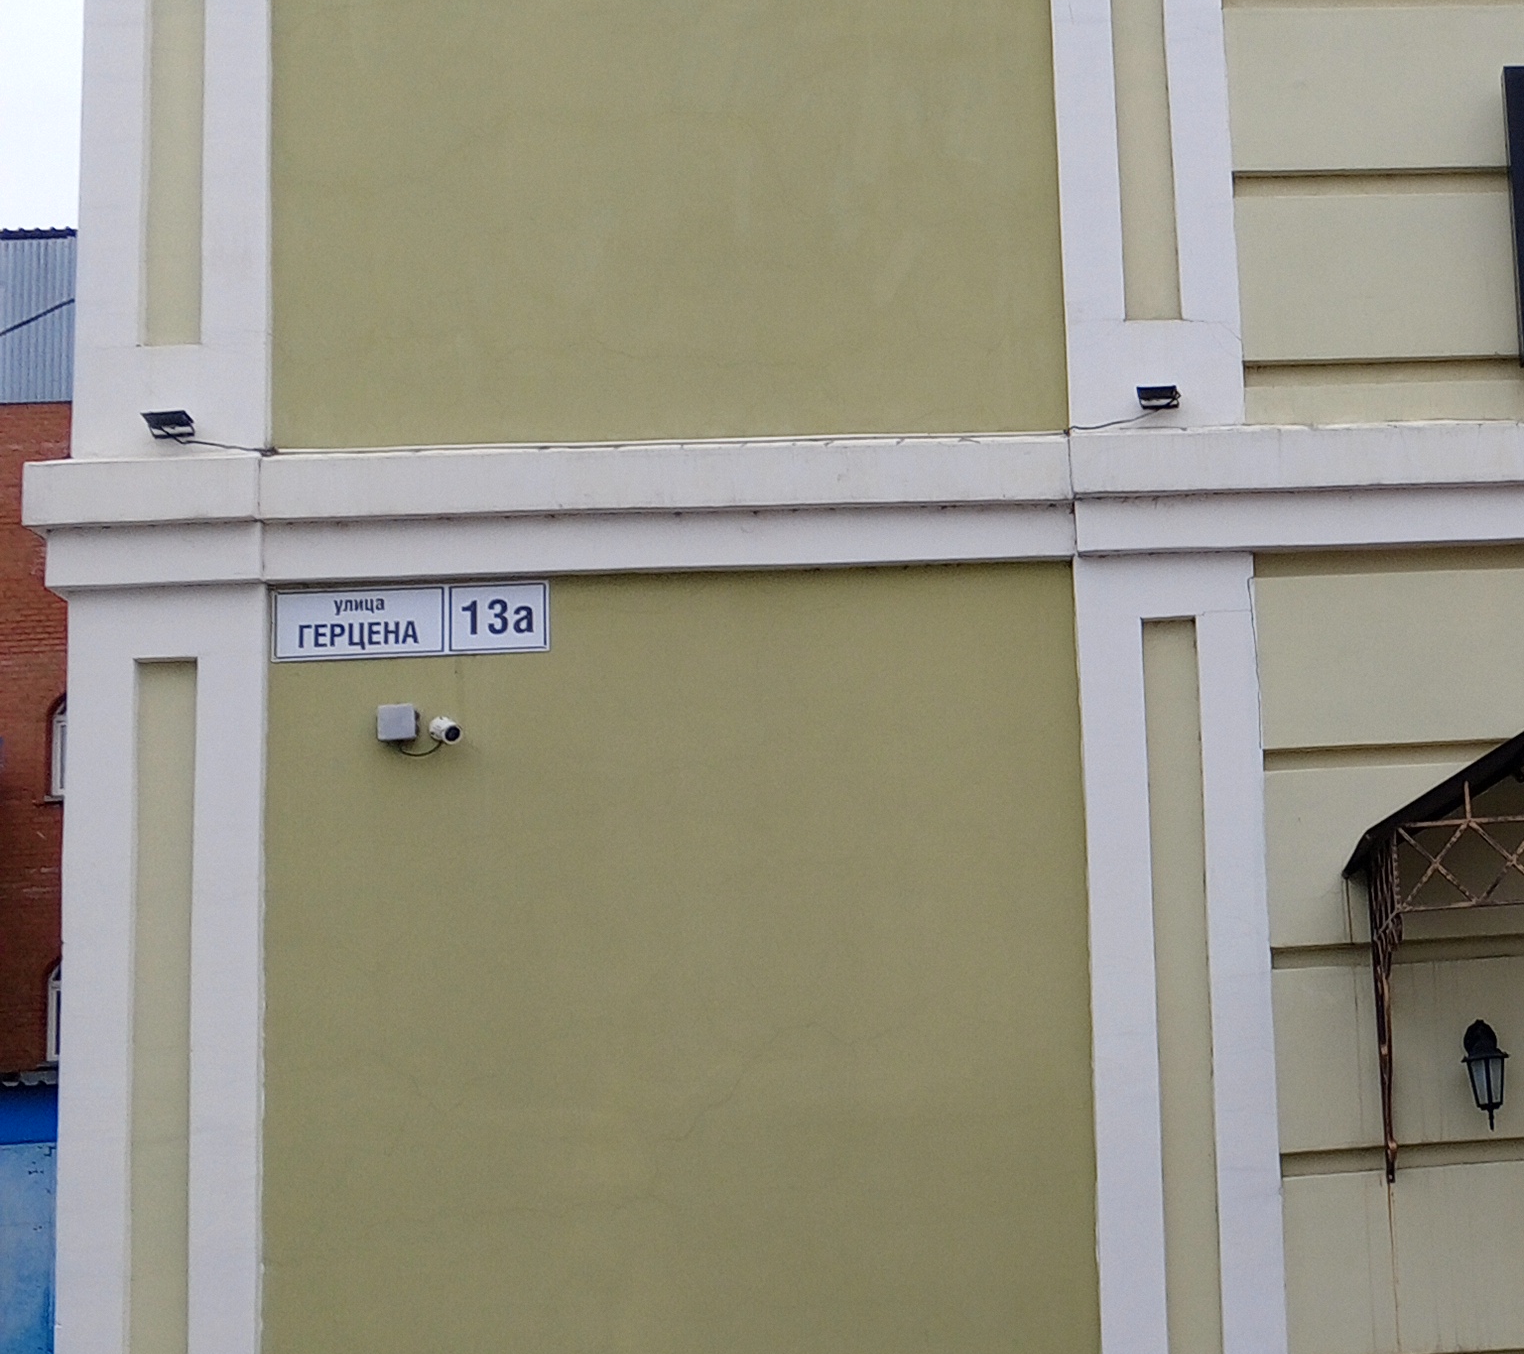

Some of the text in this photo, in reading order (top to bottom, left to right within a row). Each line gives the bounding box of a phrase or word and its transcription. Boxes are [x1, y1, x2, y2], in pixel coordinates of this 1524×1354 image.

[333, 597, 385, 616] улица
[461, 598, 534, 636] 13а
[297, 620, 419, 651] ГЕРЦЕНА
